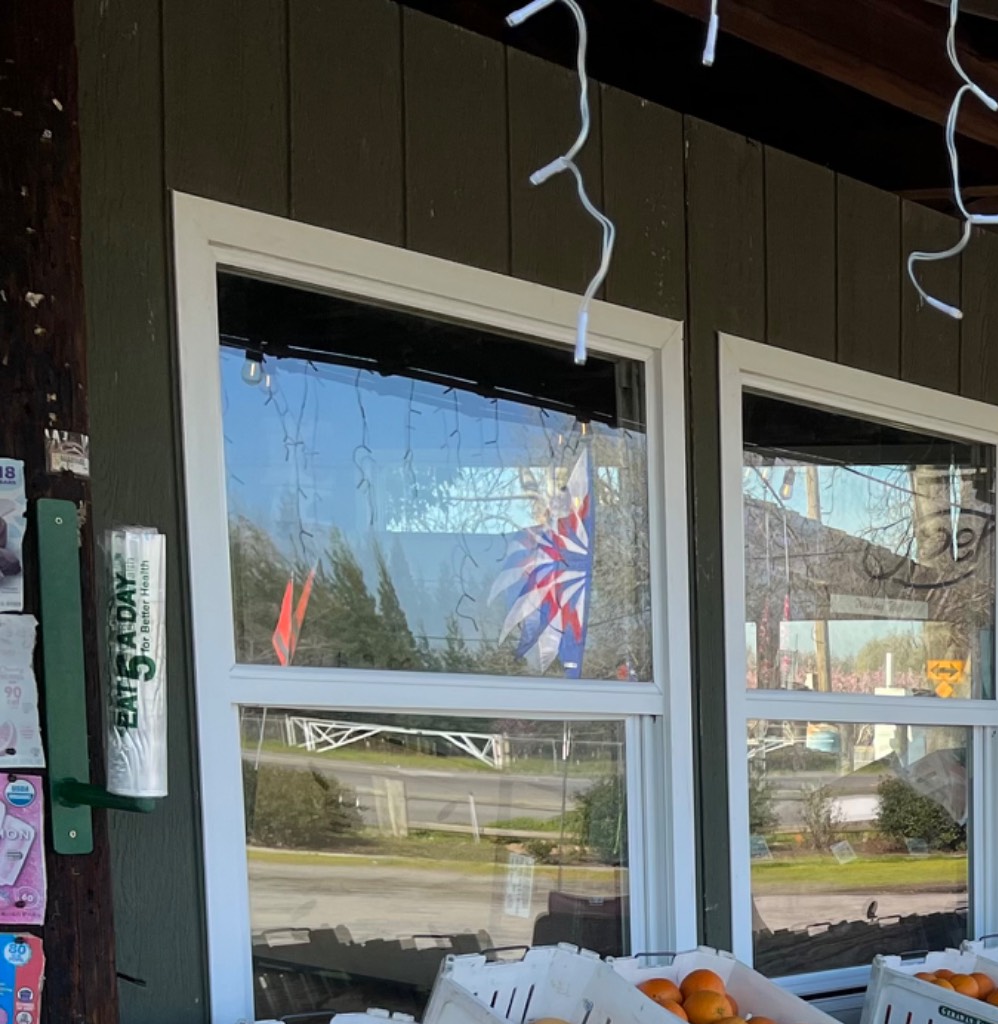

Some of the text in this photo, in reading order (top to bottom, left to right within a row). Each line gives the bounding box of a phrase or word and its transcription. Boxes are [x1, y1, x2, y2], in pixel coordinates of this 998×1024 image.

[140, 560, 150, 653] for Better Health
